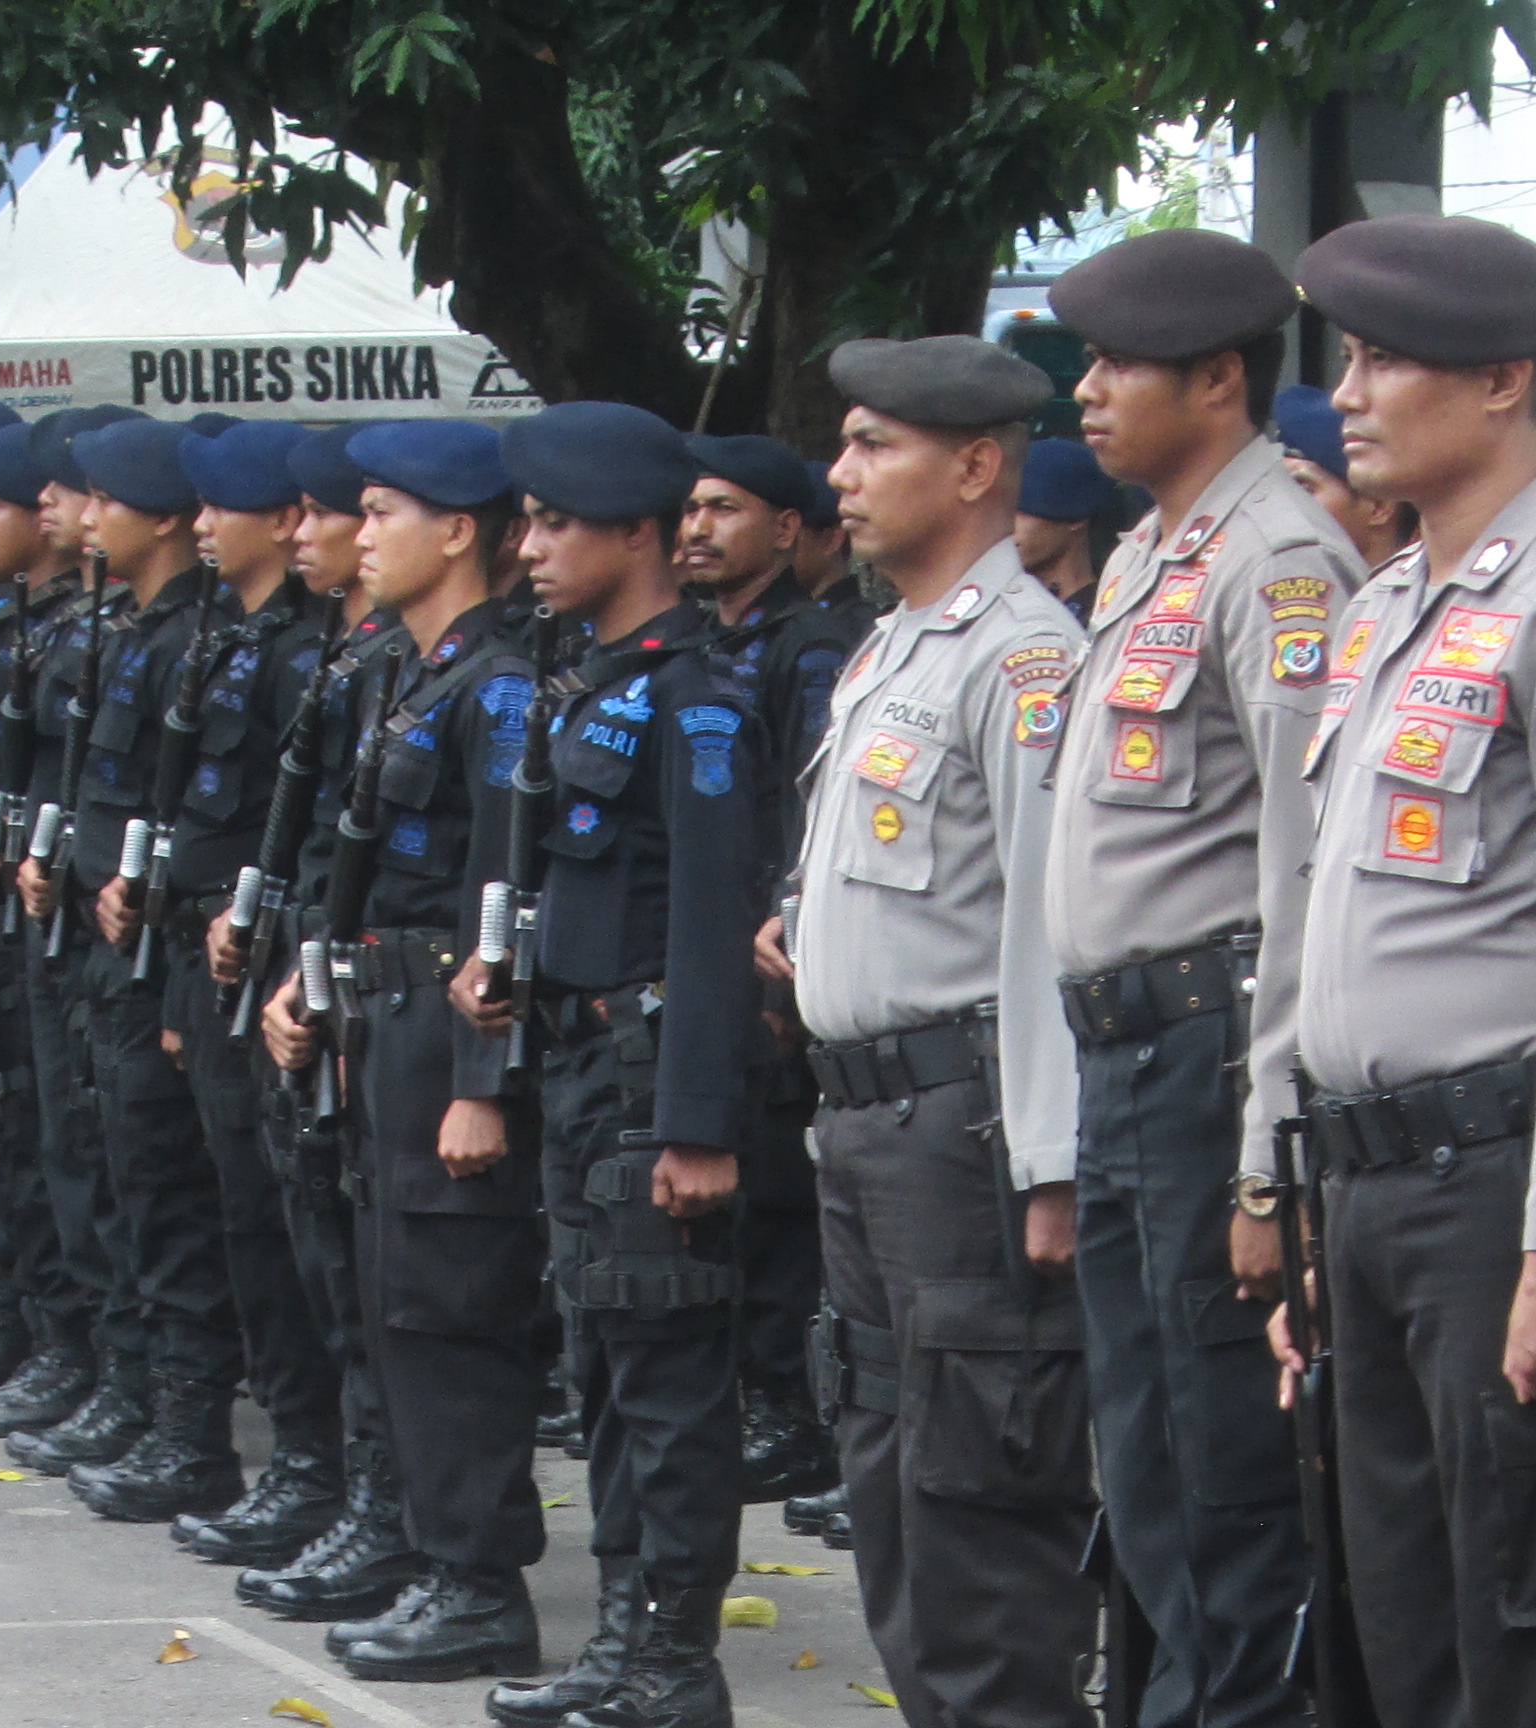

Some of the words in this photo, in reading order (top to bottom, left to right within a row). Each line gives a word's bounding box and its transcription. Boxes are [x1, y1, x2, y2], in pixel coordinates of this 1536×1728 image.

[130, 346, 294, 404] POLRES
[305, 344, 441, 402] SIKKA
[1264, 578, 1326, 597] POLRES
[1136, 624, 1197, 647] POLISI
[1005, 648, 1061, 668] POLRES
[1407, 678, 1491, 714] POLRI
[881, 701, 940, 735] POLISI
[580, 721, 640, 757] POLRI
